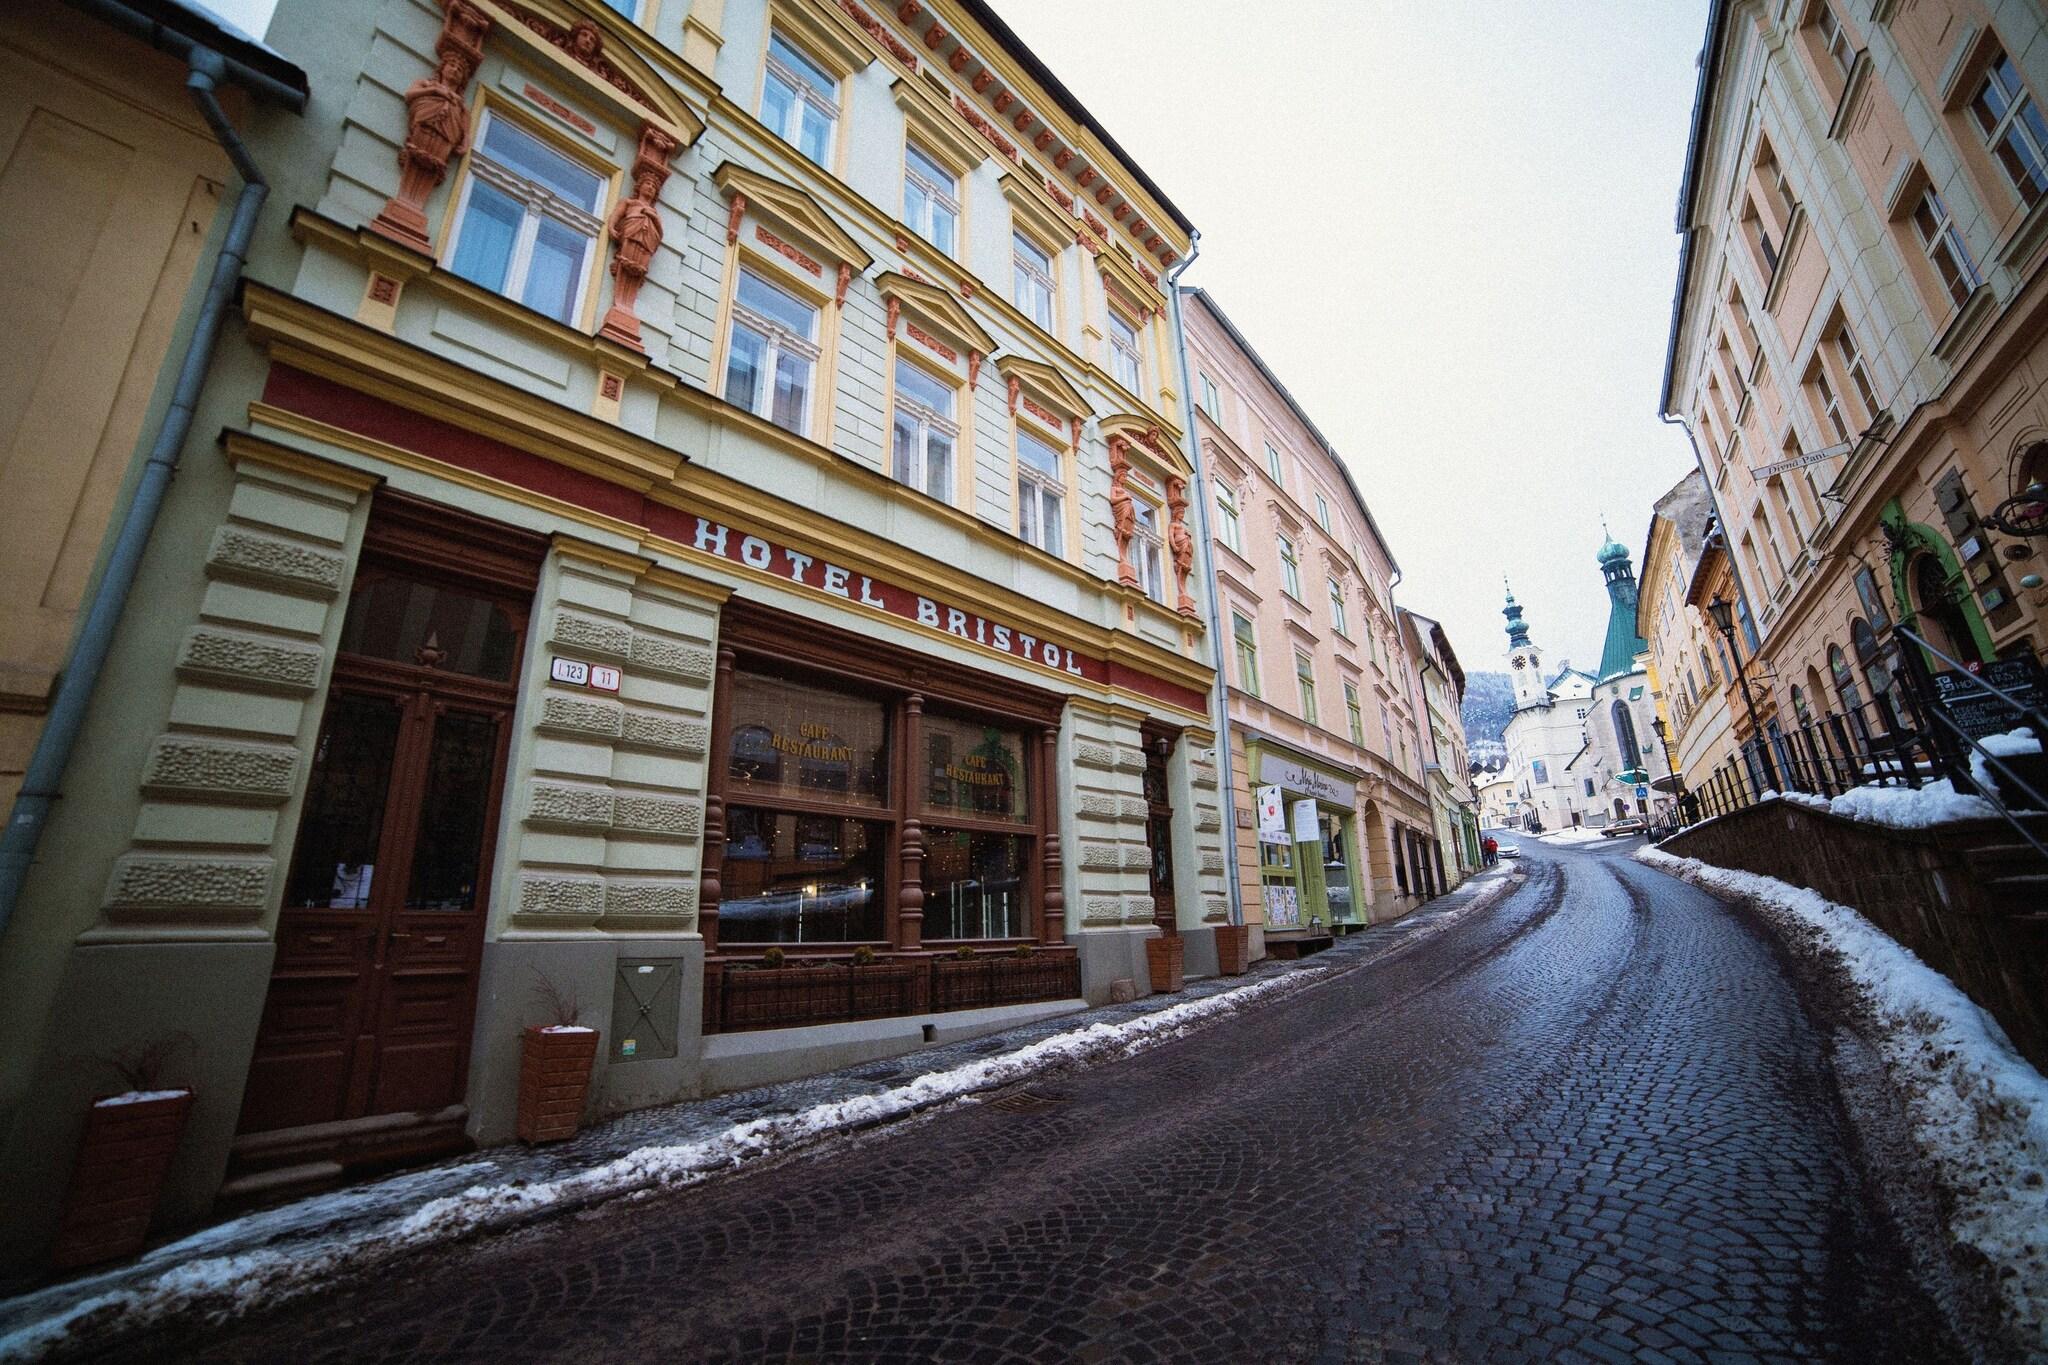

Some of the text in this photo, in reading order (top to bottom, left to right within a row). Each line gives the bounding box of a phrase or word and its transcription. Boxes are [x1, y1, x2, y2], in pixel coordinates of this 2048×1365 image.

[693, 517, 1082, 676] HOTEL BRISTOL
[566, 664, 583, 679] 123
[601, 672, 611, 685] 11
[771, 733, 852, 761] RESTAURANT
[945, 762, 1004, 785] RESTAURANT
